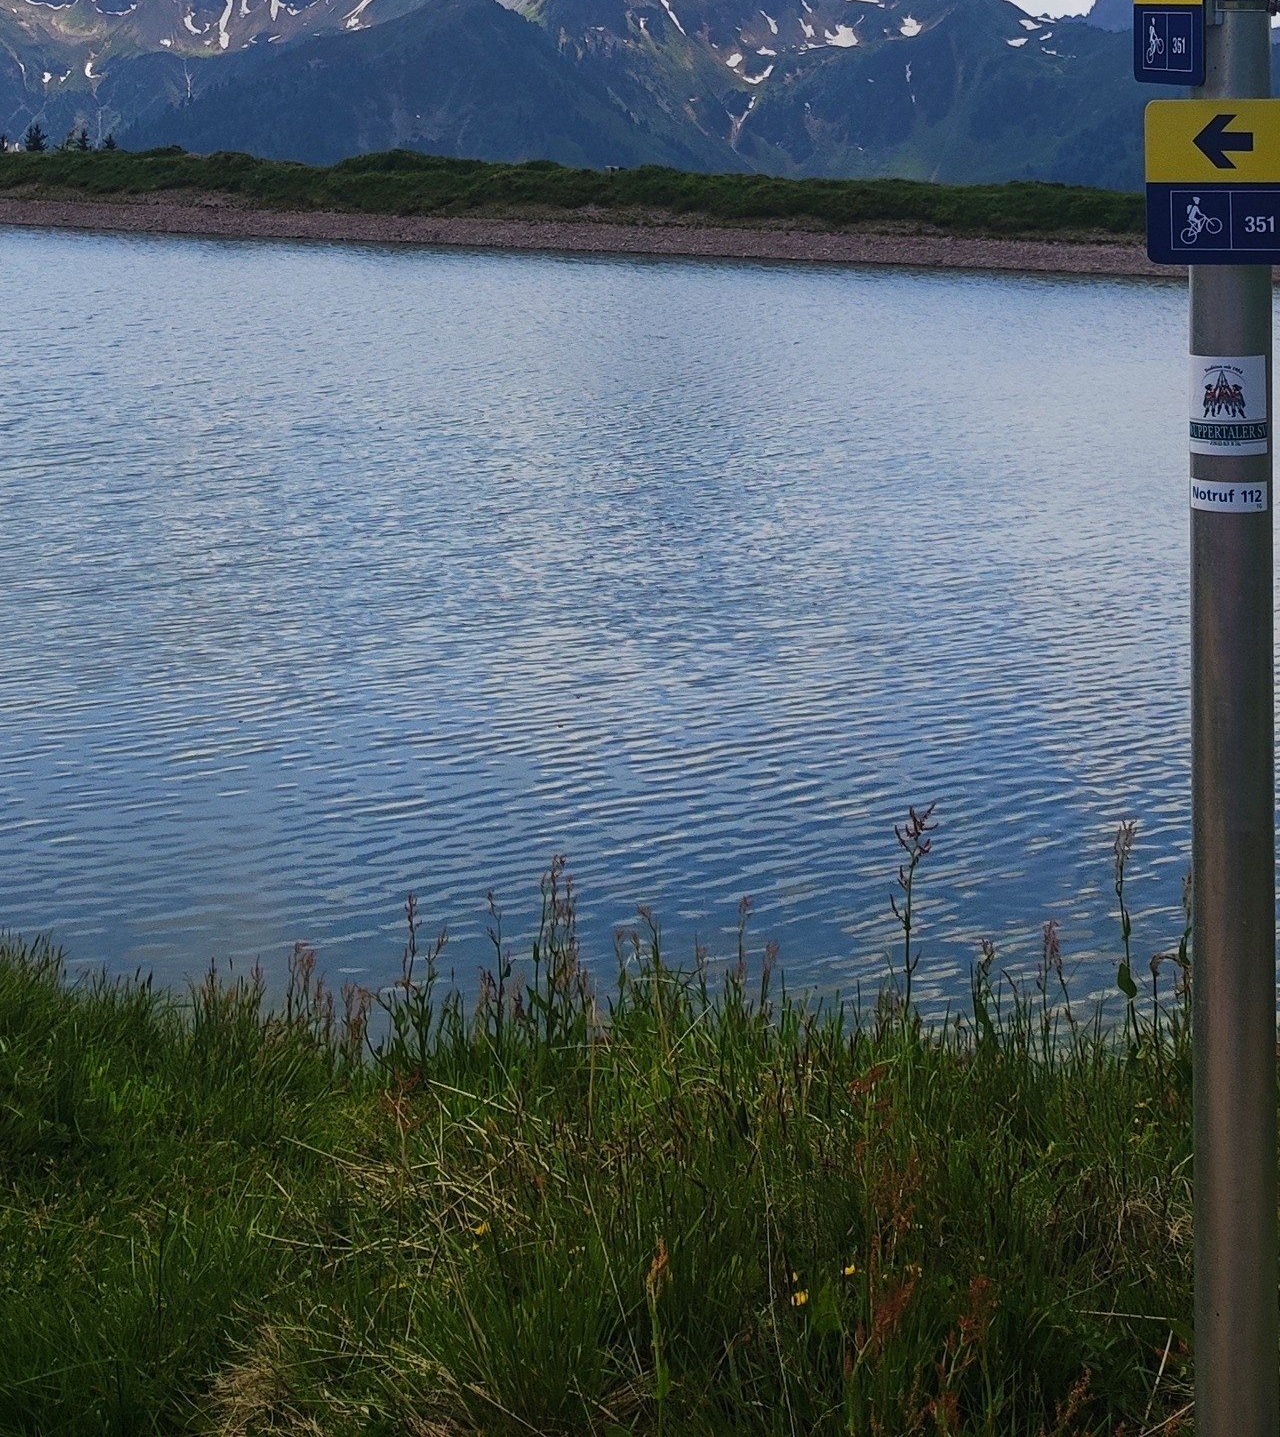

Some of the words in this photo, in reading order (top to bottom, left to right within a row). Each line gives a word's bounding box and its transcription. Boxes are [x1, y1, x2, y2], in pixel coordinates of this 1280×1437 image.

[1172, 37, 1185, 54] 351
[1245, 216, 1275, 233] 351
[1193, 486, 1234, 502] Notruf
[1241, 490, 1261, 502] 112
